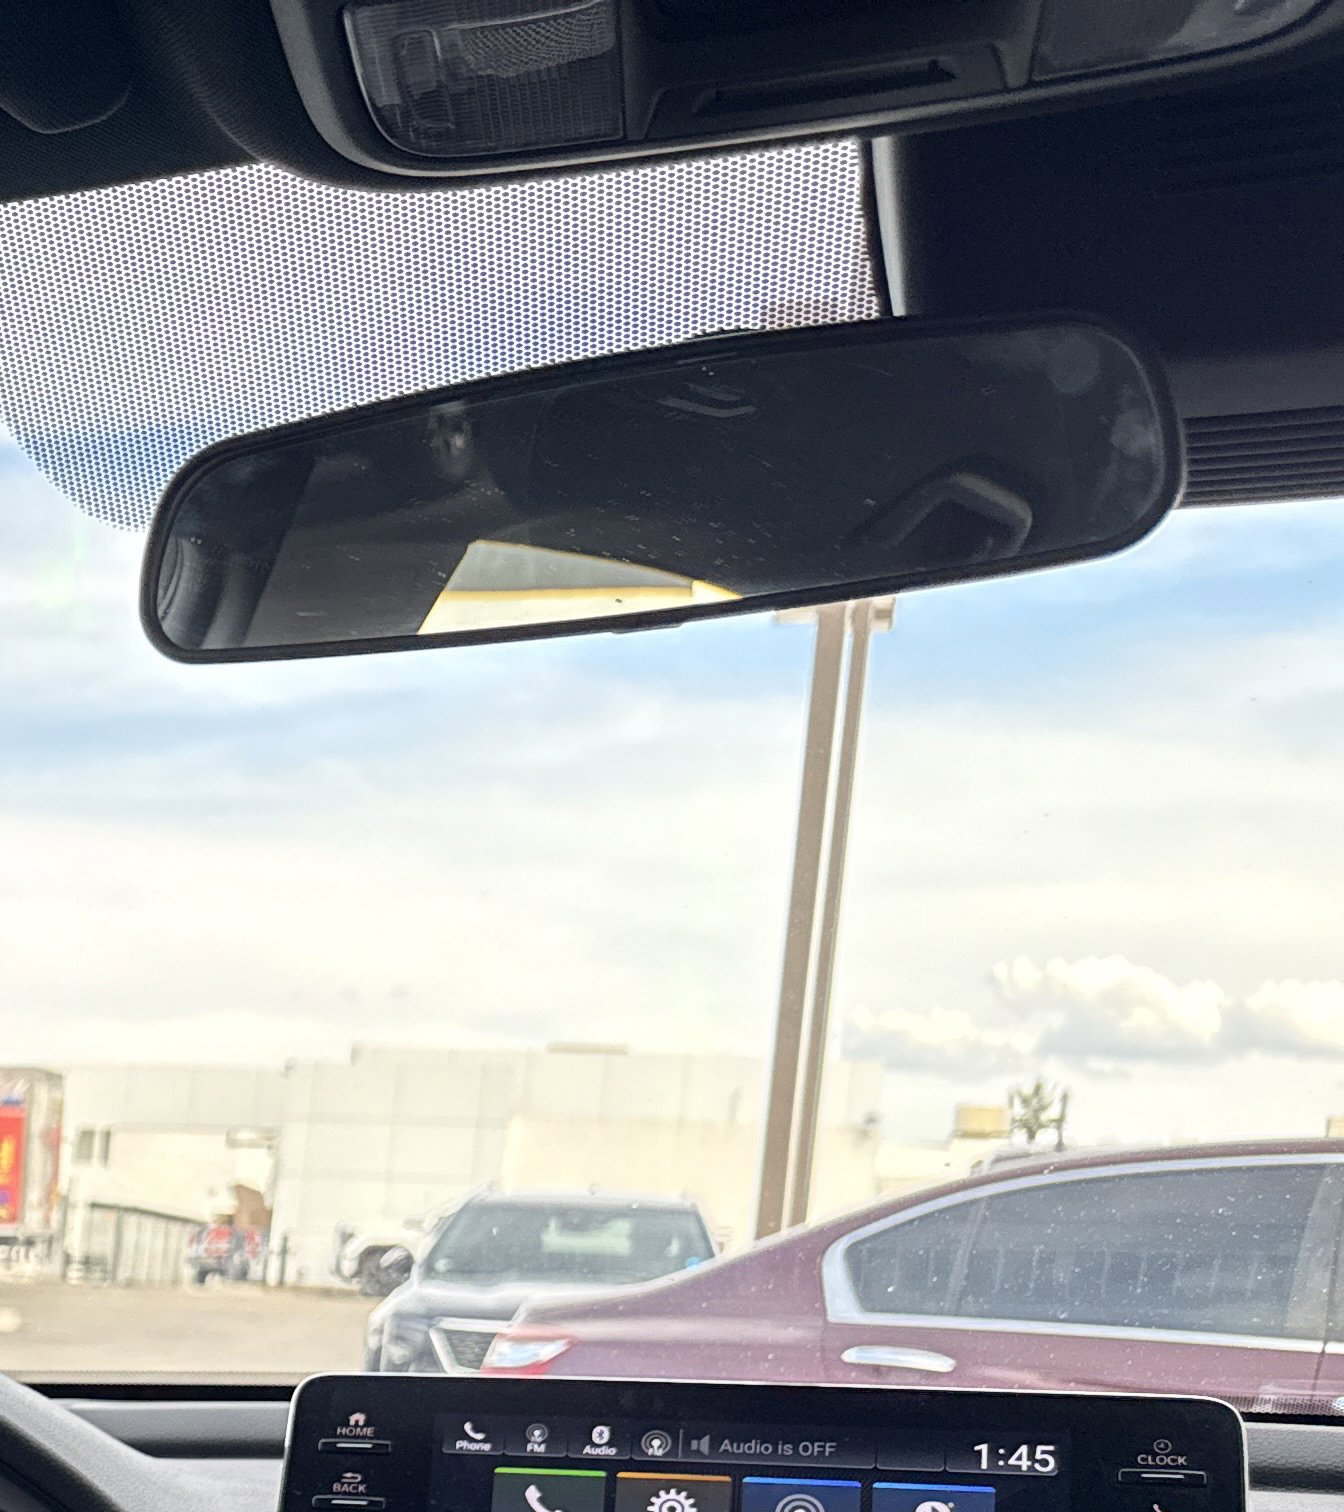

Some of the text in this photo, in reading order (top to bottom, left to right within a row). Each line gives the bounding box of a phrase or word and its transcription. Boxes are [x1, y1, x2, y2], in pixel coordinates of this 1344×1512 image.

[336, 1426, 375, 1437] HOME
[455, 1440, 492, 1452] Phone
[526, 1443, 546, 1454] FM
[582, 1445, 617, 1456] Audio
[718, 1439, 838, 1457] Audio is OFF
[973, 1443, 1055, 1473] 1:45
[1137, 1454, 1187, 1467] CLOCK
[332, 1482, 367, 1494] BACK
